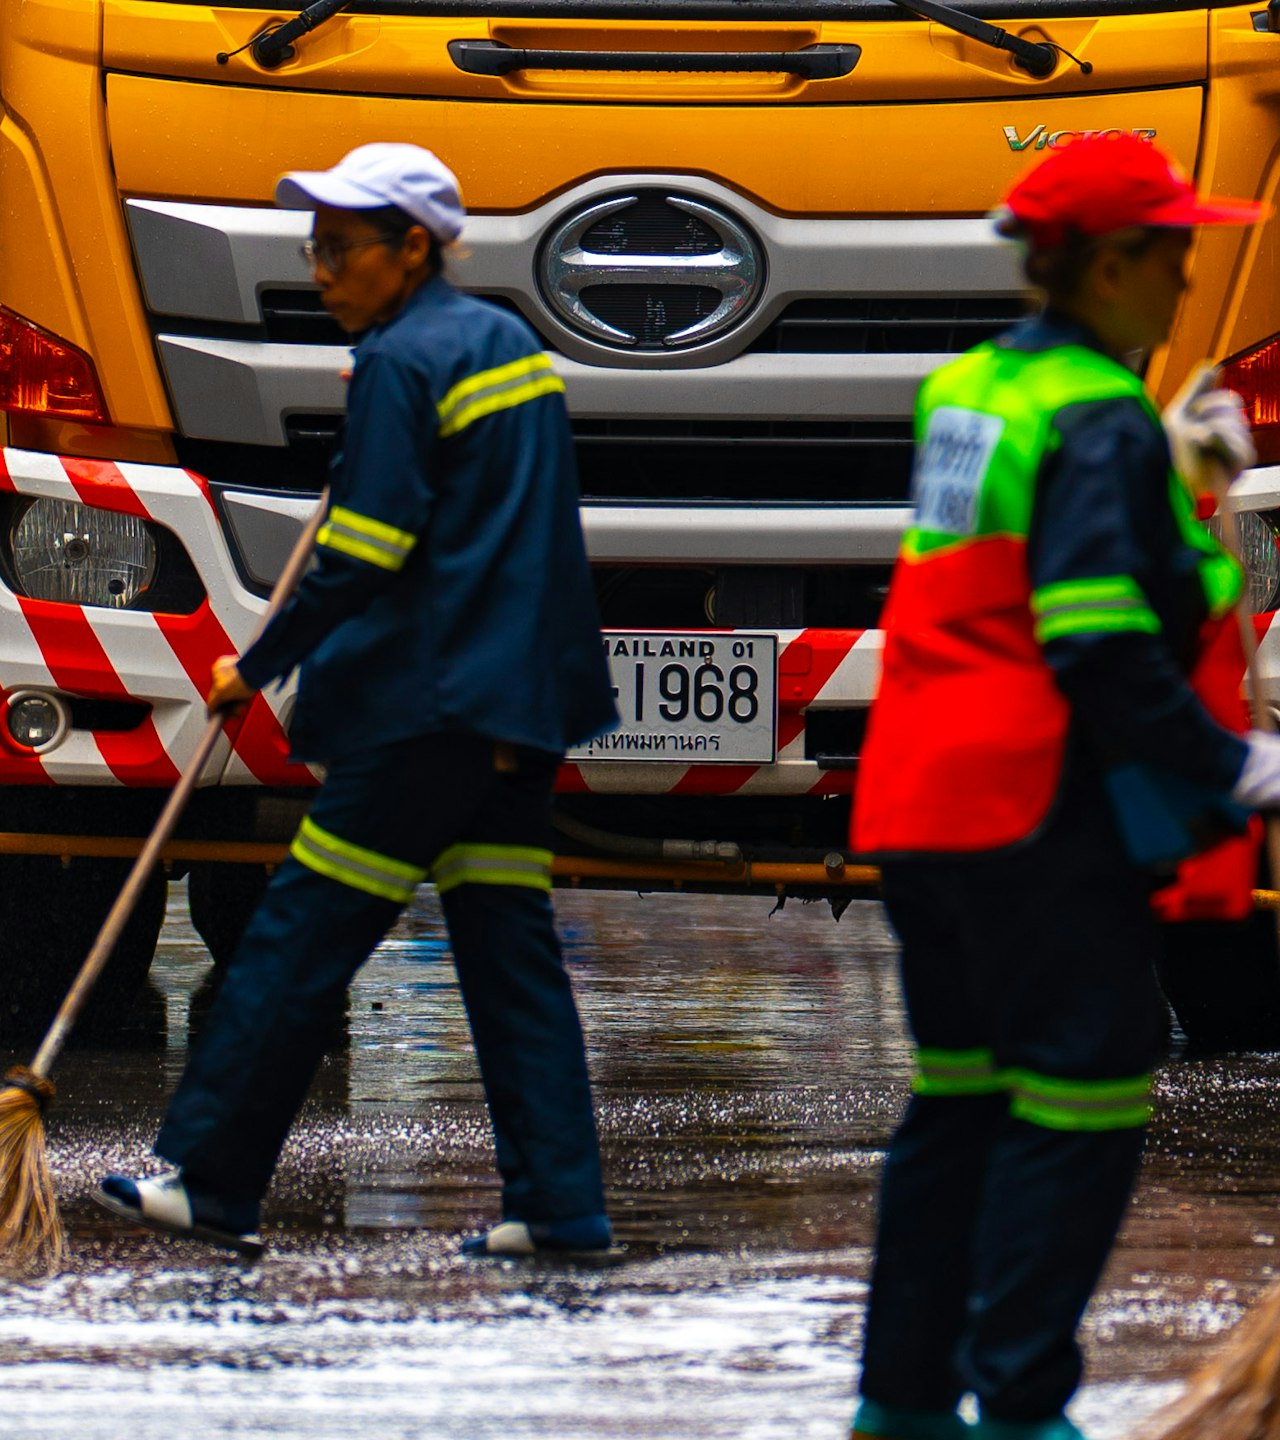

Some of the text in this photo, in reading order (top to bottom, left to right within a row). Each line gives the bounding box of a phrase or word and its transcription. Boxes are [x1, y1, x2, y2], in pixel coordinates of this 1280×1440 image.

[603, 639, 755, 659] AILAND 01
[574, 733, 722, 756] รุงเทพมหานคร
